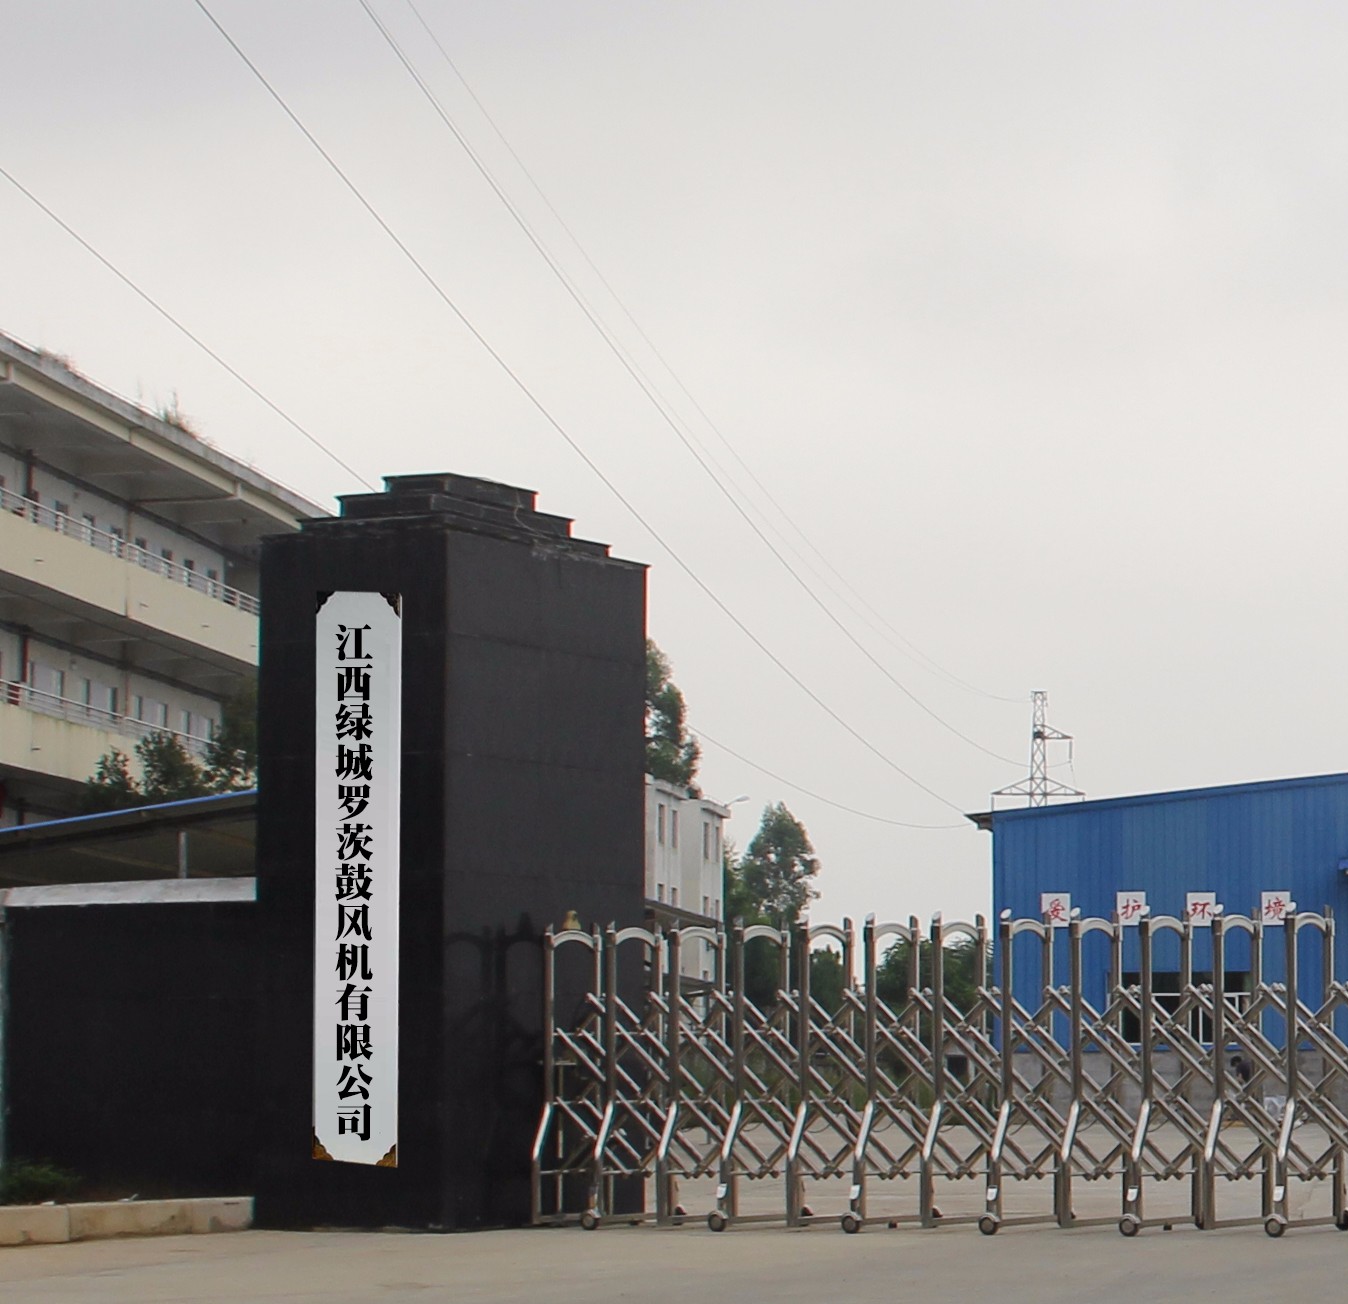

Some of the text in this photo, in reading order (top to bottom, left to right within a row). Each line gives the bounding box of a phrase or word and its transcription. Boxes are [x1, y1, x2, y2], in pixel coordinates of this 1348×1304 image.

[334, 623, 374, 1142] 江西绿城罗茨鼓风机有限公司
